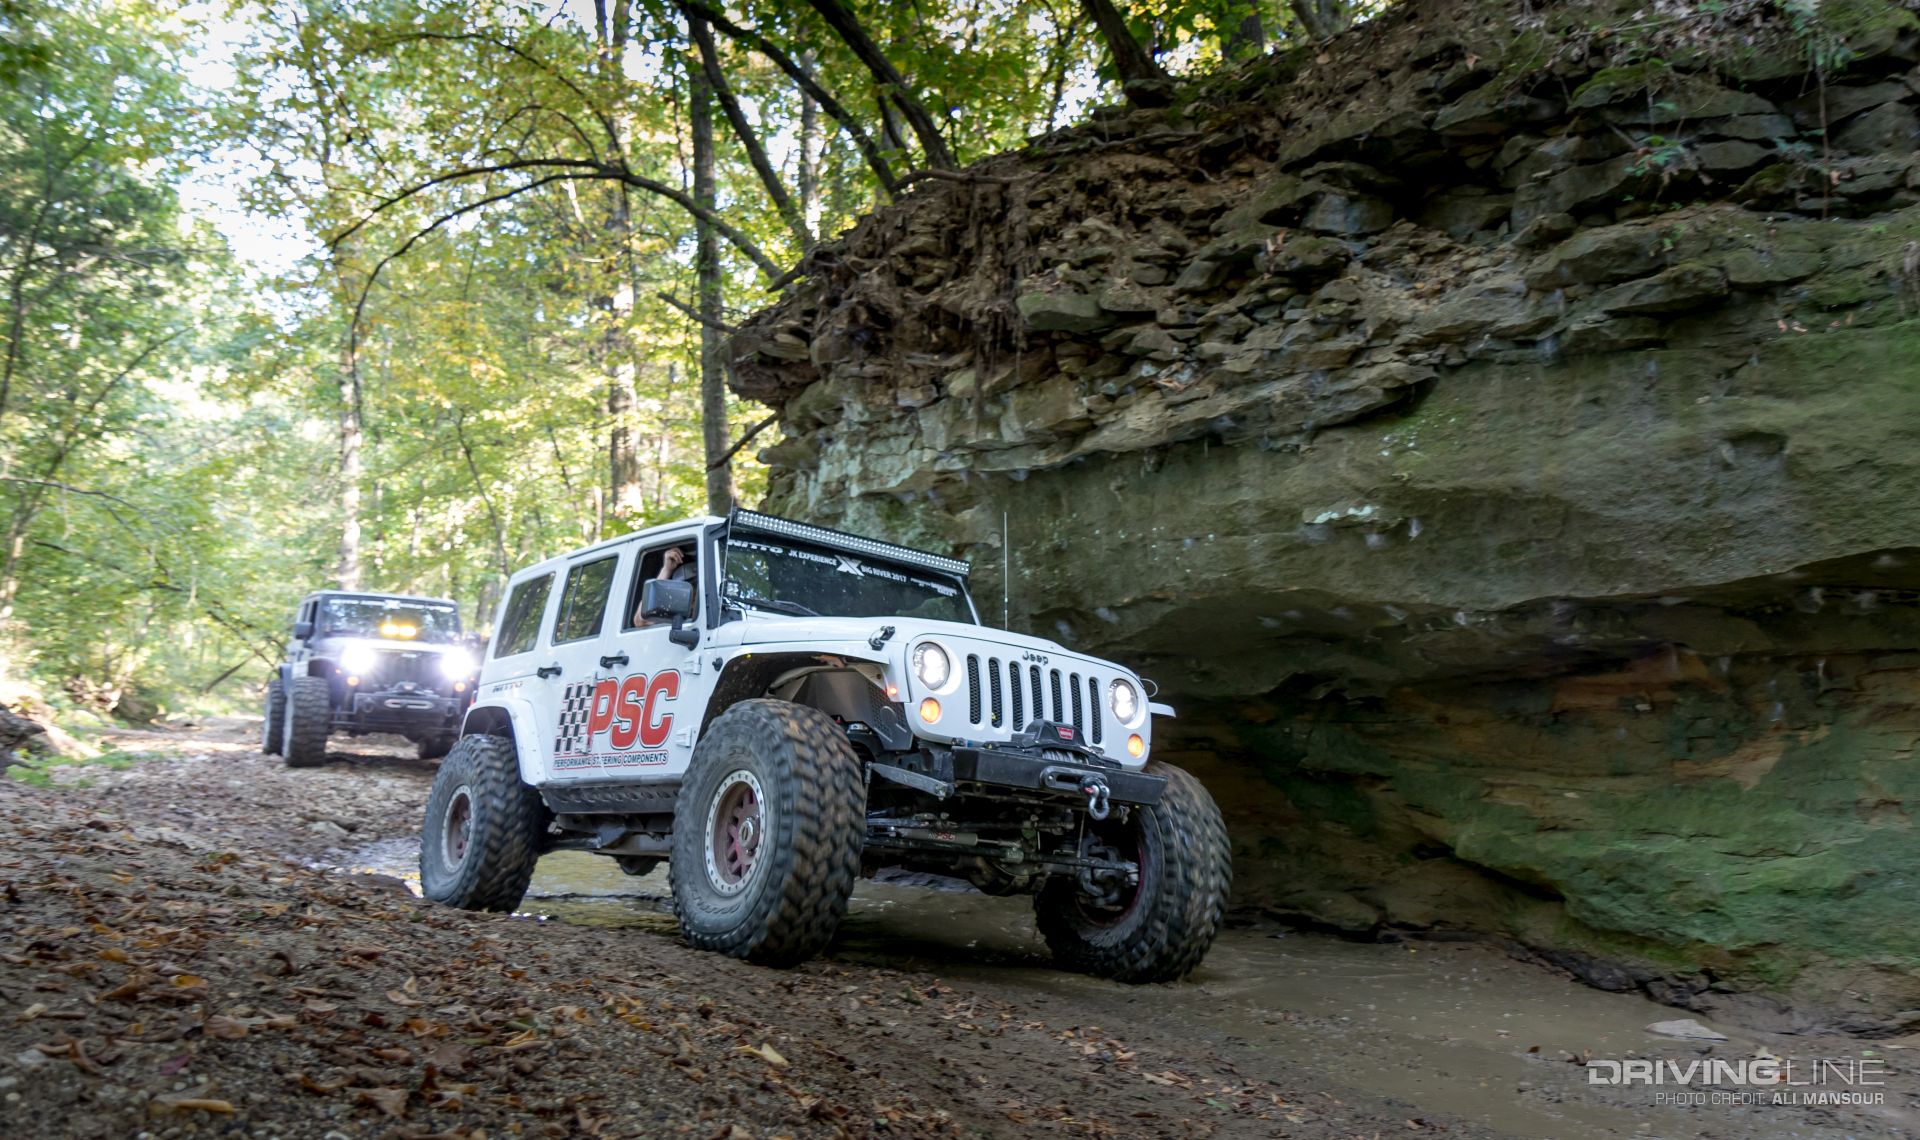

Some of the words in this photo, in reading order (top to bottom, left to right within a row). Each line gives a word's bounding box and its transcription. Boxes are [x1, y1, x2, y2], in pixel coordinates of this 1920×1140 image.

[727, 539, 783, 554] NITTO
[788, 549, 798, 558] JK
[799, 552, 837, 566] EXPERIENCE
[861, 565, 873, 574] BIG
[873, 568, 892, 579] RIVER
[892, 572, 907, 583] 2017
[1022, 651, 1048, 665] Jeep
[587, 668, 681, 751] PSC
[623, 752, 668, 764] COMPONENTS
